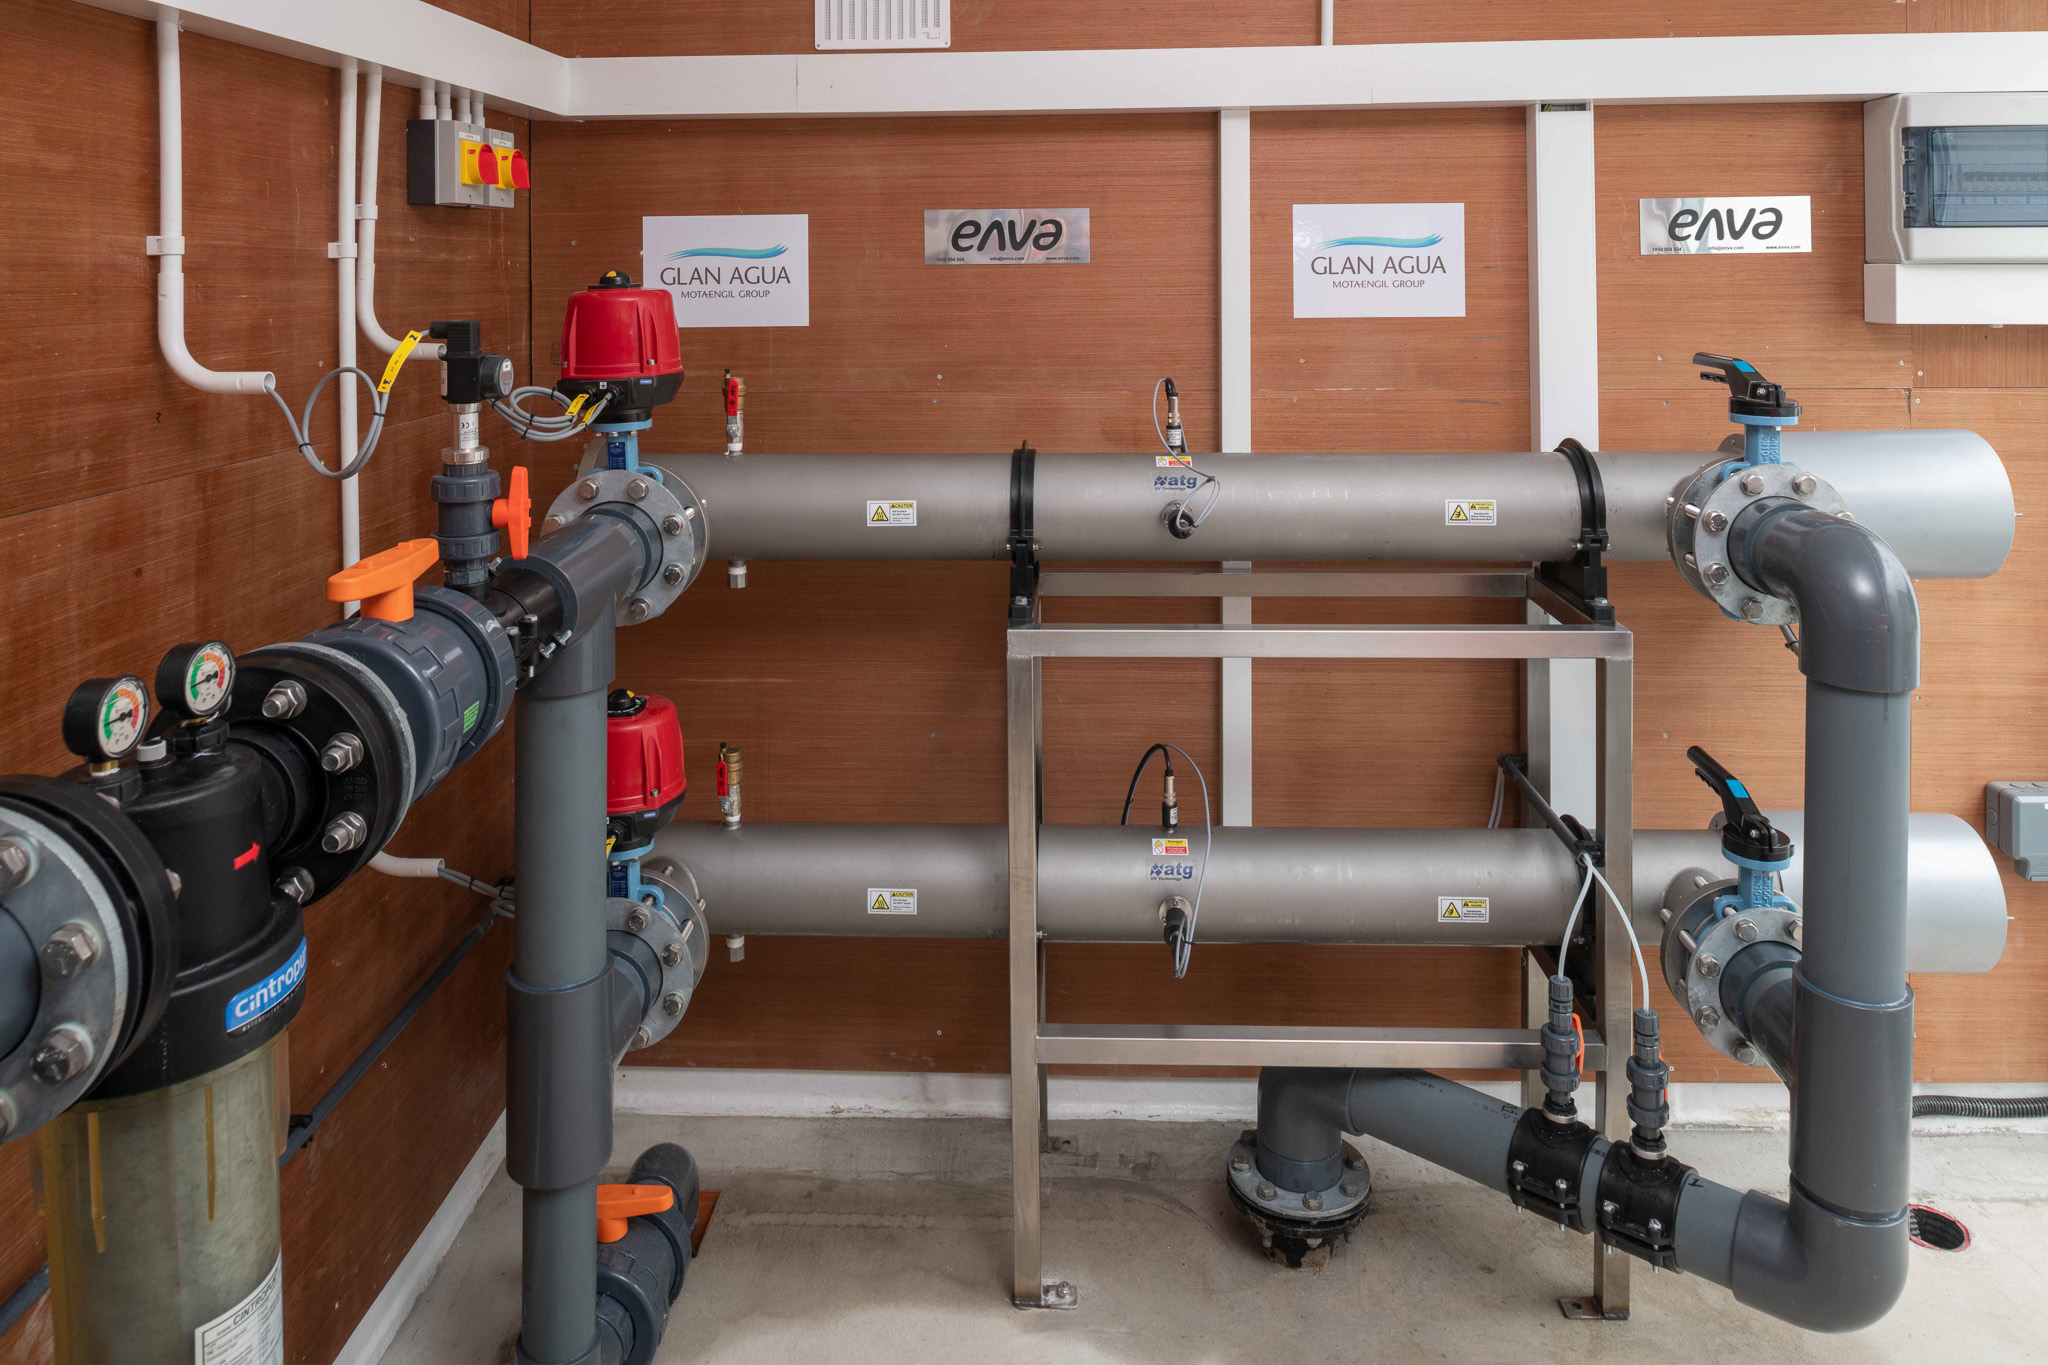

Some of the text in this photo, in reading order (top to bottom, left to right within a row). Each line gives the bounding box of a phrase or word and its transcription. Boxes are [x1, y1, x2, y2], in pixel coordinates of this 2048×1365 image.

[1668, 207, 1783, 241] enva
[951, 218, 1063, 252] enva
[1310, 255, 1447, 275] GLAN AGUA
[660, 266, 791, 286] GLAN AGUA
[1392, 279, 1425, 288] GROUP
[738, 289, 770, 298] GROUP
[1168, 475, 1198, 489] atg
[1164, 863, 1193, 879] atg
